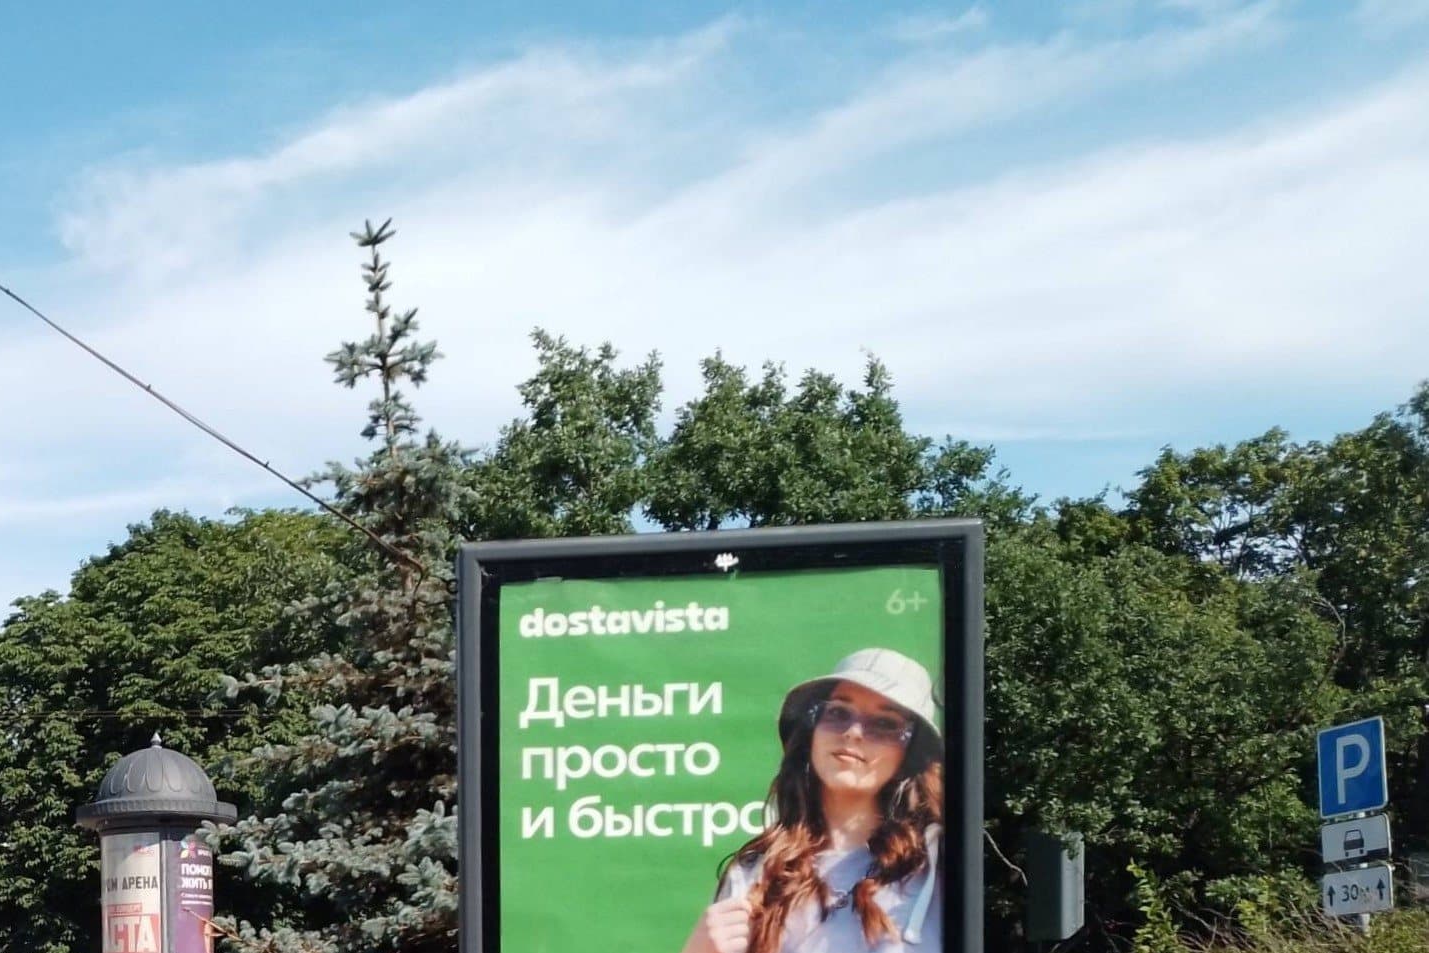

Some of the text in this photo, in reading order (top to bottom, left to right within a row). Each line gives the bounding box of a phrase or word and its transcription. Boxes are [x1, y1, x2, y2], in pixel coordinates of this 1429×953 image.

[518, 600, 730, 639] dostavista
[884, 587, 929, 616] 6+
[518, 676, 723, 729] Деньги
[521, 741, 721, 791] просто
[1336, 734, 1370, 804] P
[521, 795, 775, 847] и быстро
[122, 876, 158, 890] АРЕНА
